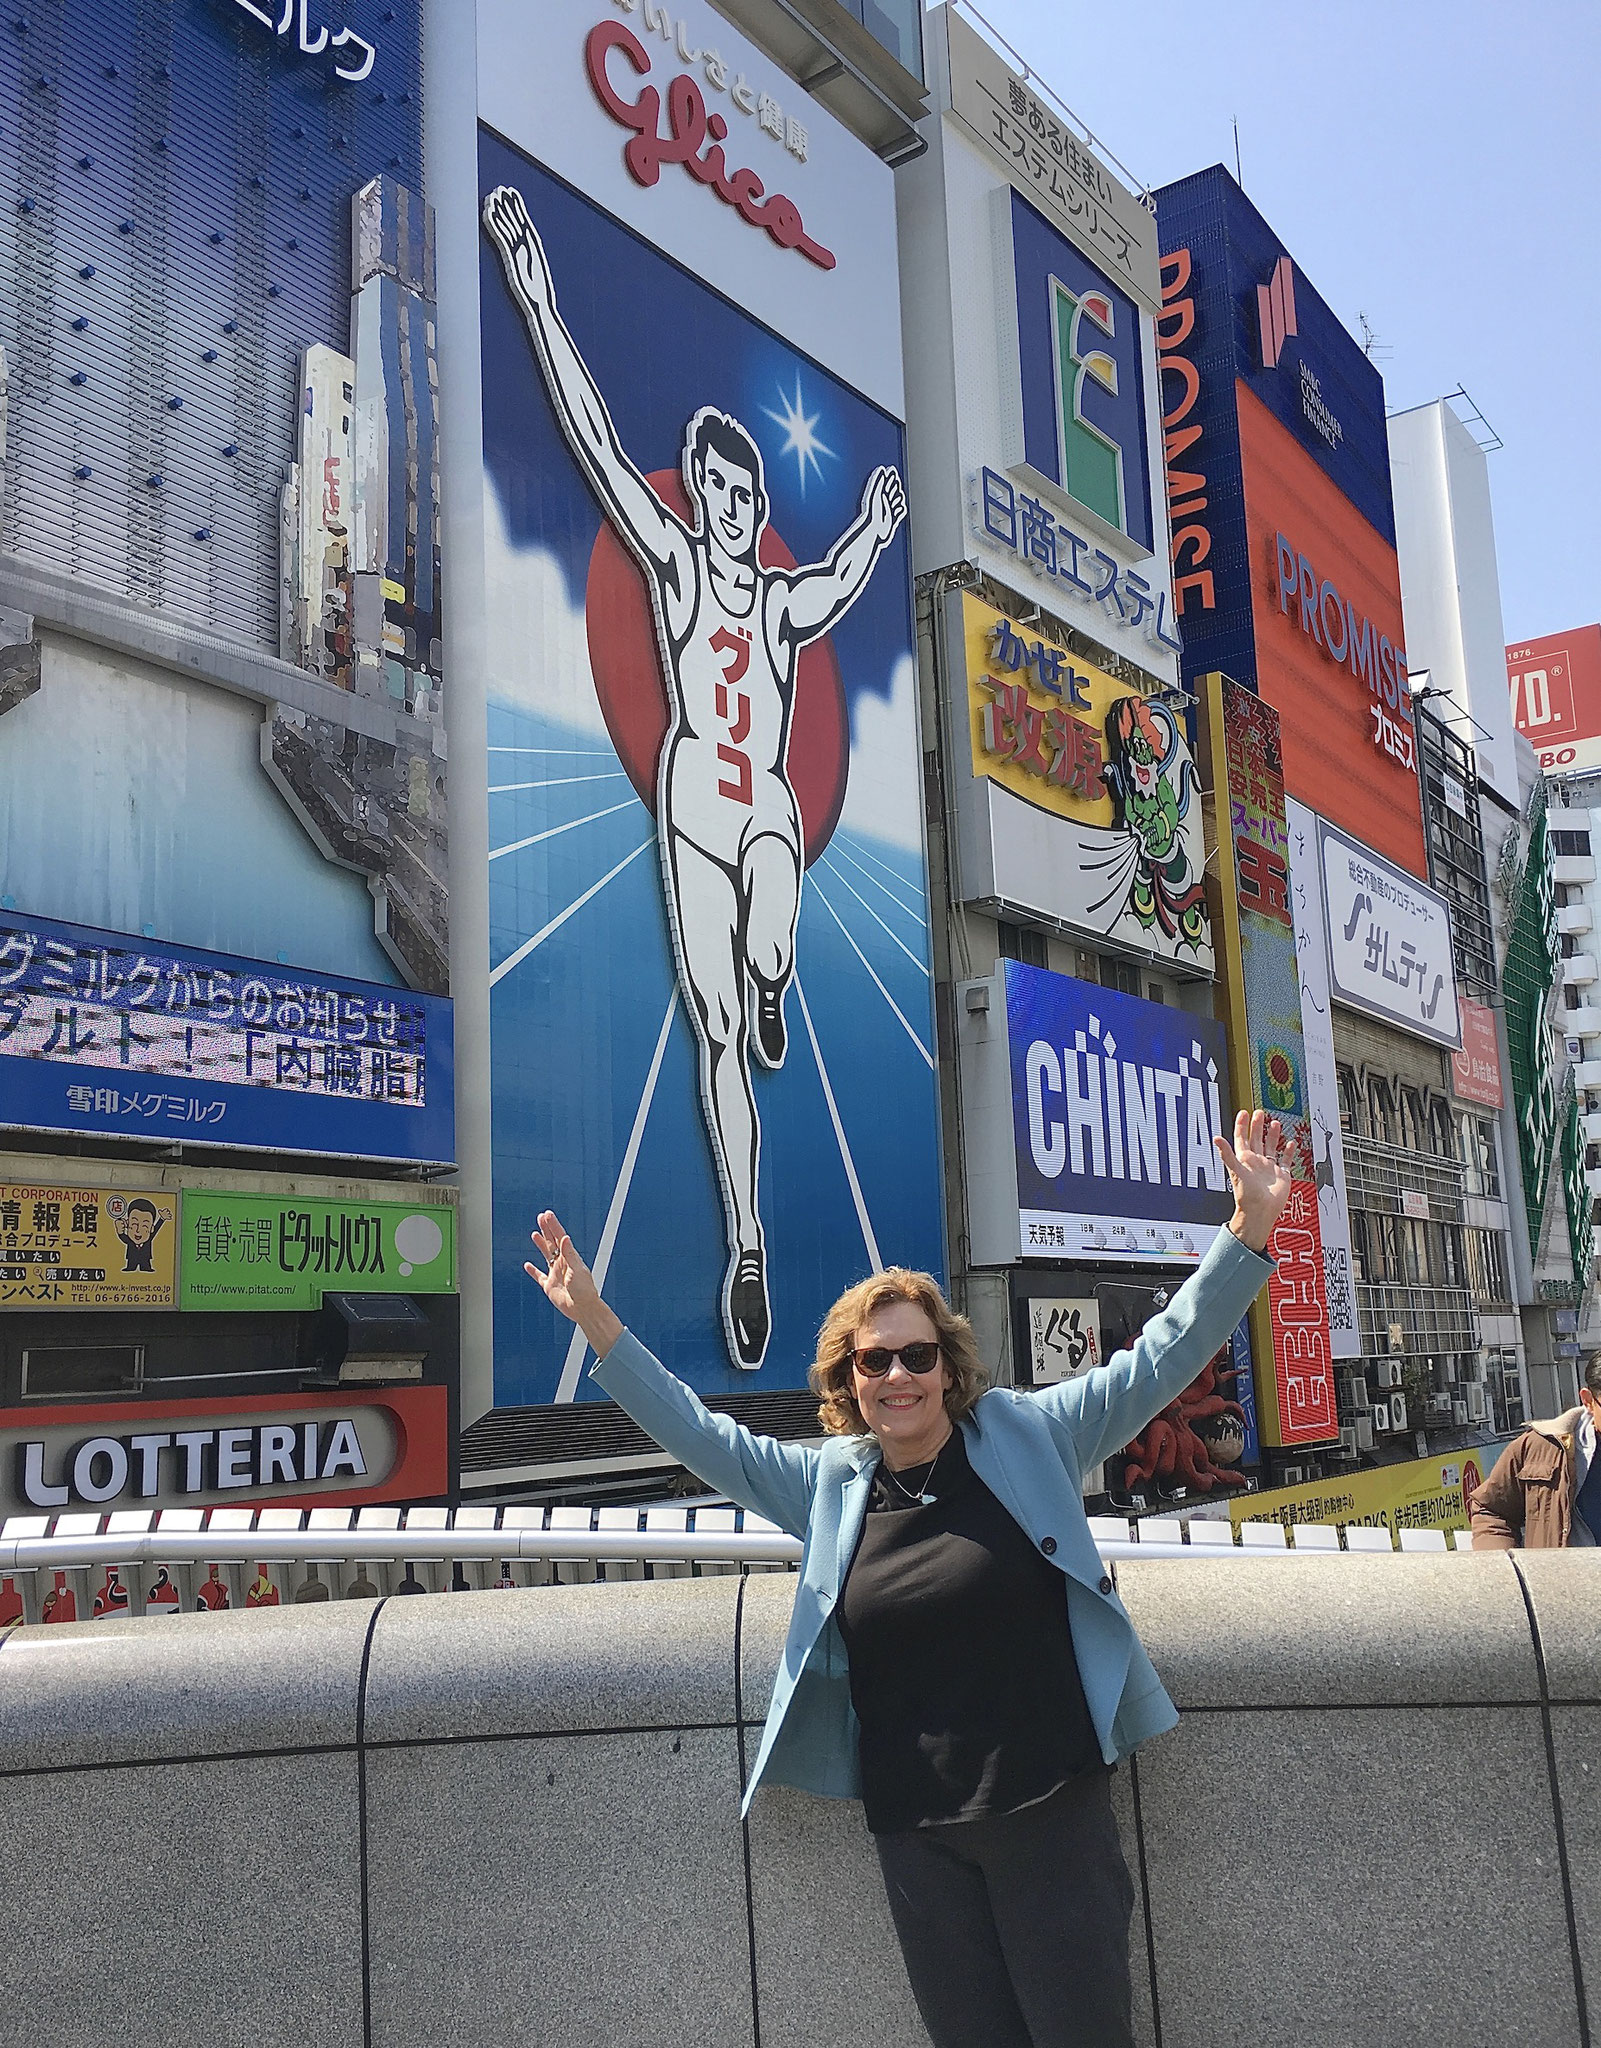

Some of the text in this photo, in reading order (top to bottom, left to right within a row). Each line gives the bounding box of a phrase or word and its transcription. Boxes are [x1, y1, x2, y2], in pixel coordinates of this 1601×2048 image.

[585, 20, 837, 270] Glico
[1008, 77, 1113, 204] 夢ある住まい
[992, 110, 1132, 271] エステムシリーズ
[1299, 359, 1322, 398] SMBC
[1301, 379, 1345, 442] CONSUMER
[1303, 397, 1337, 450] FINANCE
[1276, 530, 1412, 724] PROMISE
[1507, 648, 1535, 661] 1876.
[988, 618, 1092, 711] かぜに
[708, 625, 753, 806] グリコ
[973, 674, 1107, 801] 改源
[1370, 703, 1417, 773] プロミス
[1232, 801, 1289, 845] スーパー
[1236, 834, 1292, 928] 玉
[1347, 858, 1434, 922] 総合不動産のプロデューサー
[0, 932, 399, 1045] グミルクからのお知らせ
[1363, 922, 1428, 995] サムティ
[66, 1084, 227, 1124] 雪印メグミルク
[1026, 1028, 1227, 1193] CHINTAI
[12, 1188, 98, 1203] CORPORATION
[111, 1200, 122, 1212] 店
[0, 1232, 98, 1248] 合プロデュース
[194, 1210, 386, 1274] 賃貸・売買 ピタットハウス
[1028, 1224, 1065, 1246] 天気予報
[2, 1283, 64, 1301] ンベスト
[46, 1268, 105, 1280] 売りたい
[71, 1284, 171, 1293] http://www.k-invest.co.jp
[71, 1293, 171, 1303] TEL 06-6766-2016
[190, 1283, 297, 1295] http://www.pitat.com/
[20, 1419, 368, 1507] LOTTERIA
